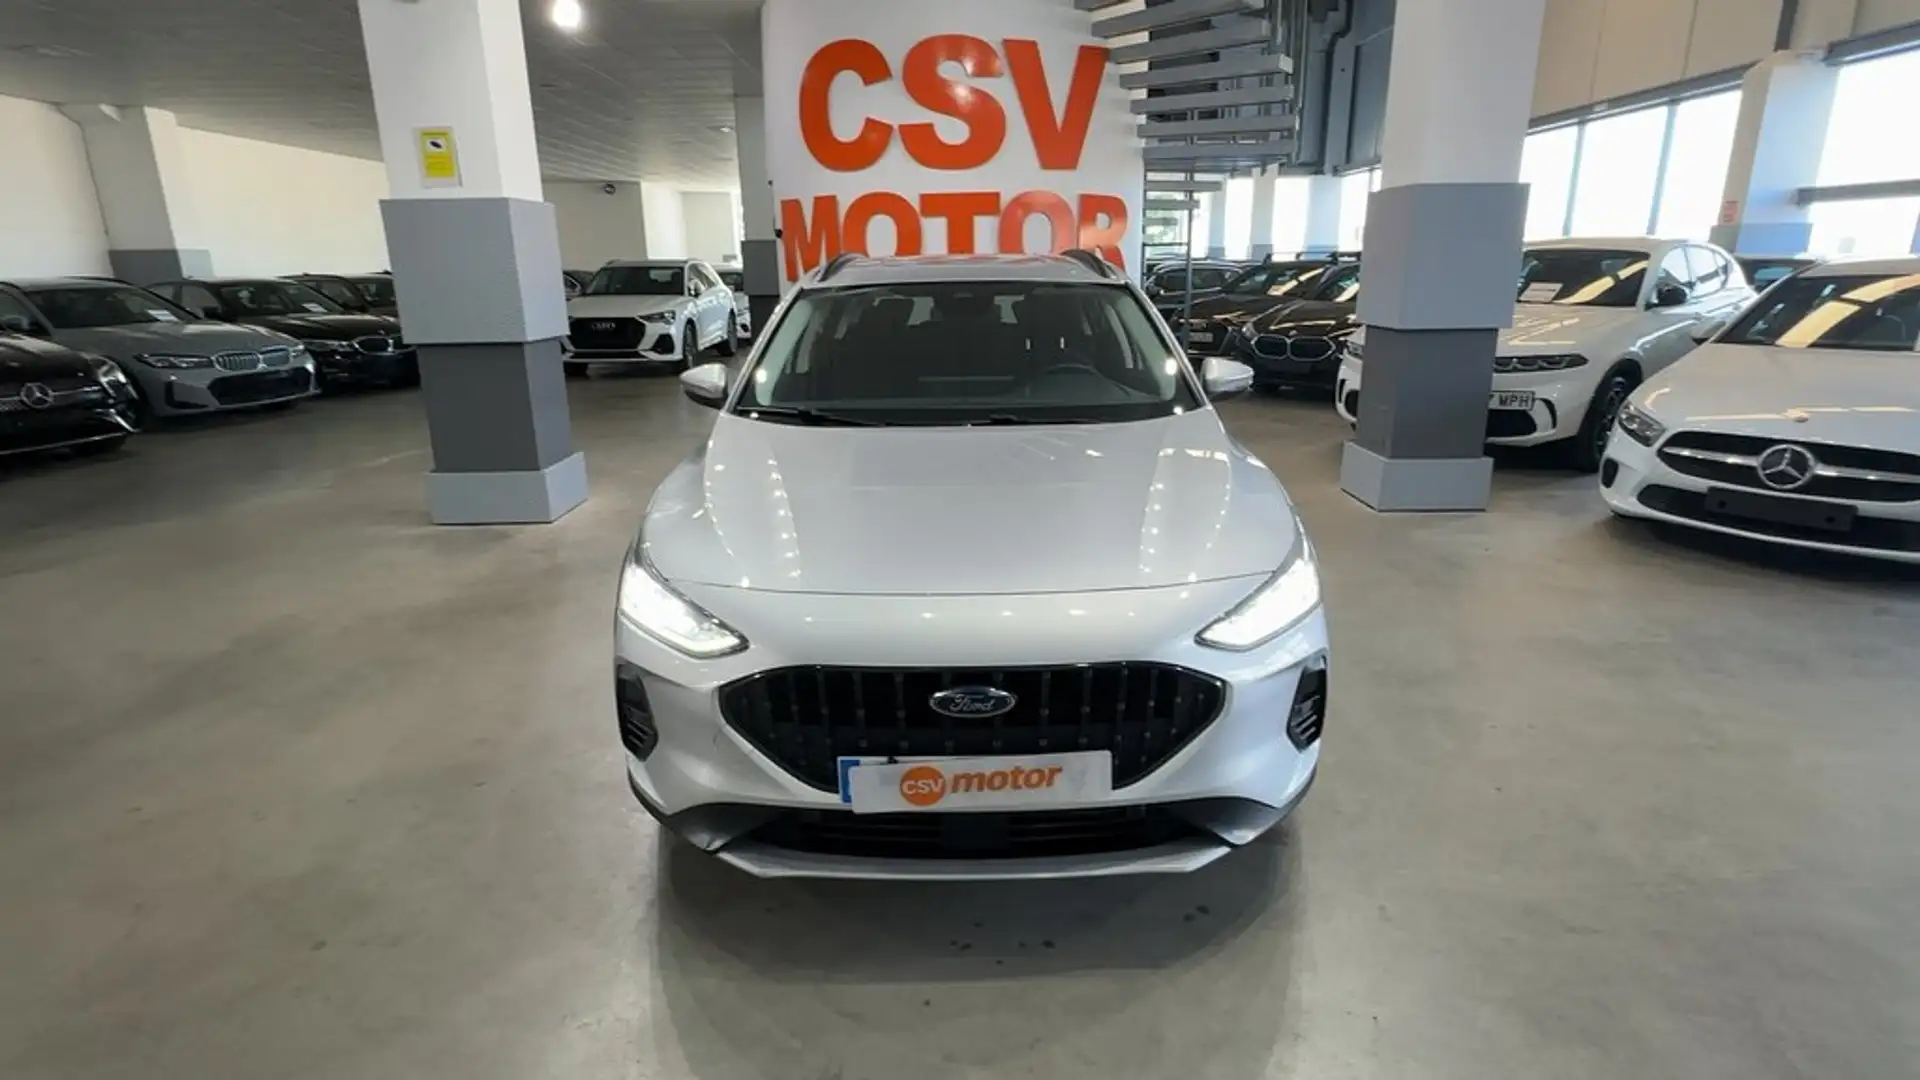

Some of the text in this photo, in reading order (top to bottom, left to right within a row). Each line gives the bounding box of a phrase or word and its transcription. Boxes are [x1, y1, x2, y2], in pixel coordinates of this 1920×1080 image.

[799, 34, 1111, 171] CSV
[781, 190, 1128, 282] MOTOR
[949, 694, 995, 712] Ford
[902, 765, 1063, 795] CSV motor
